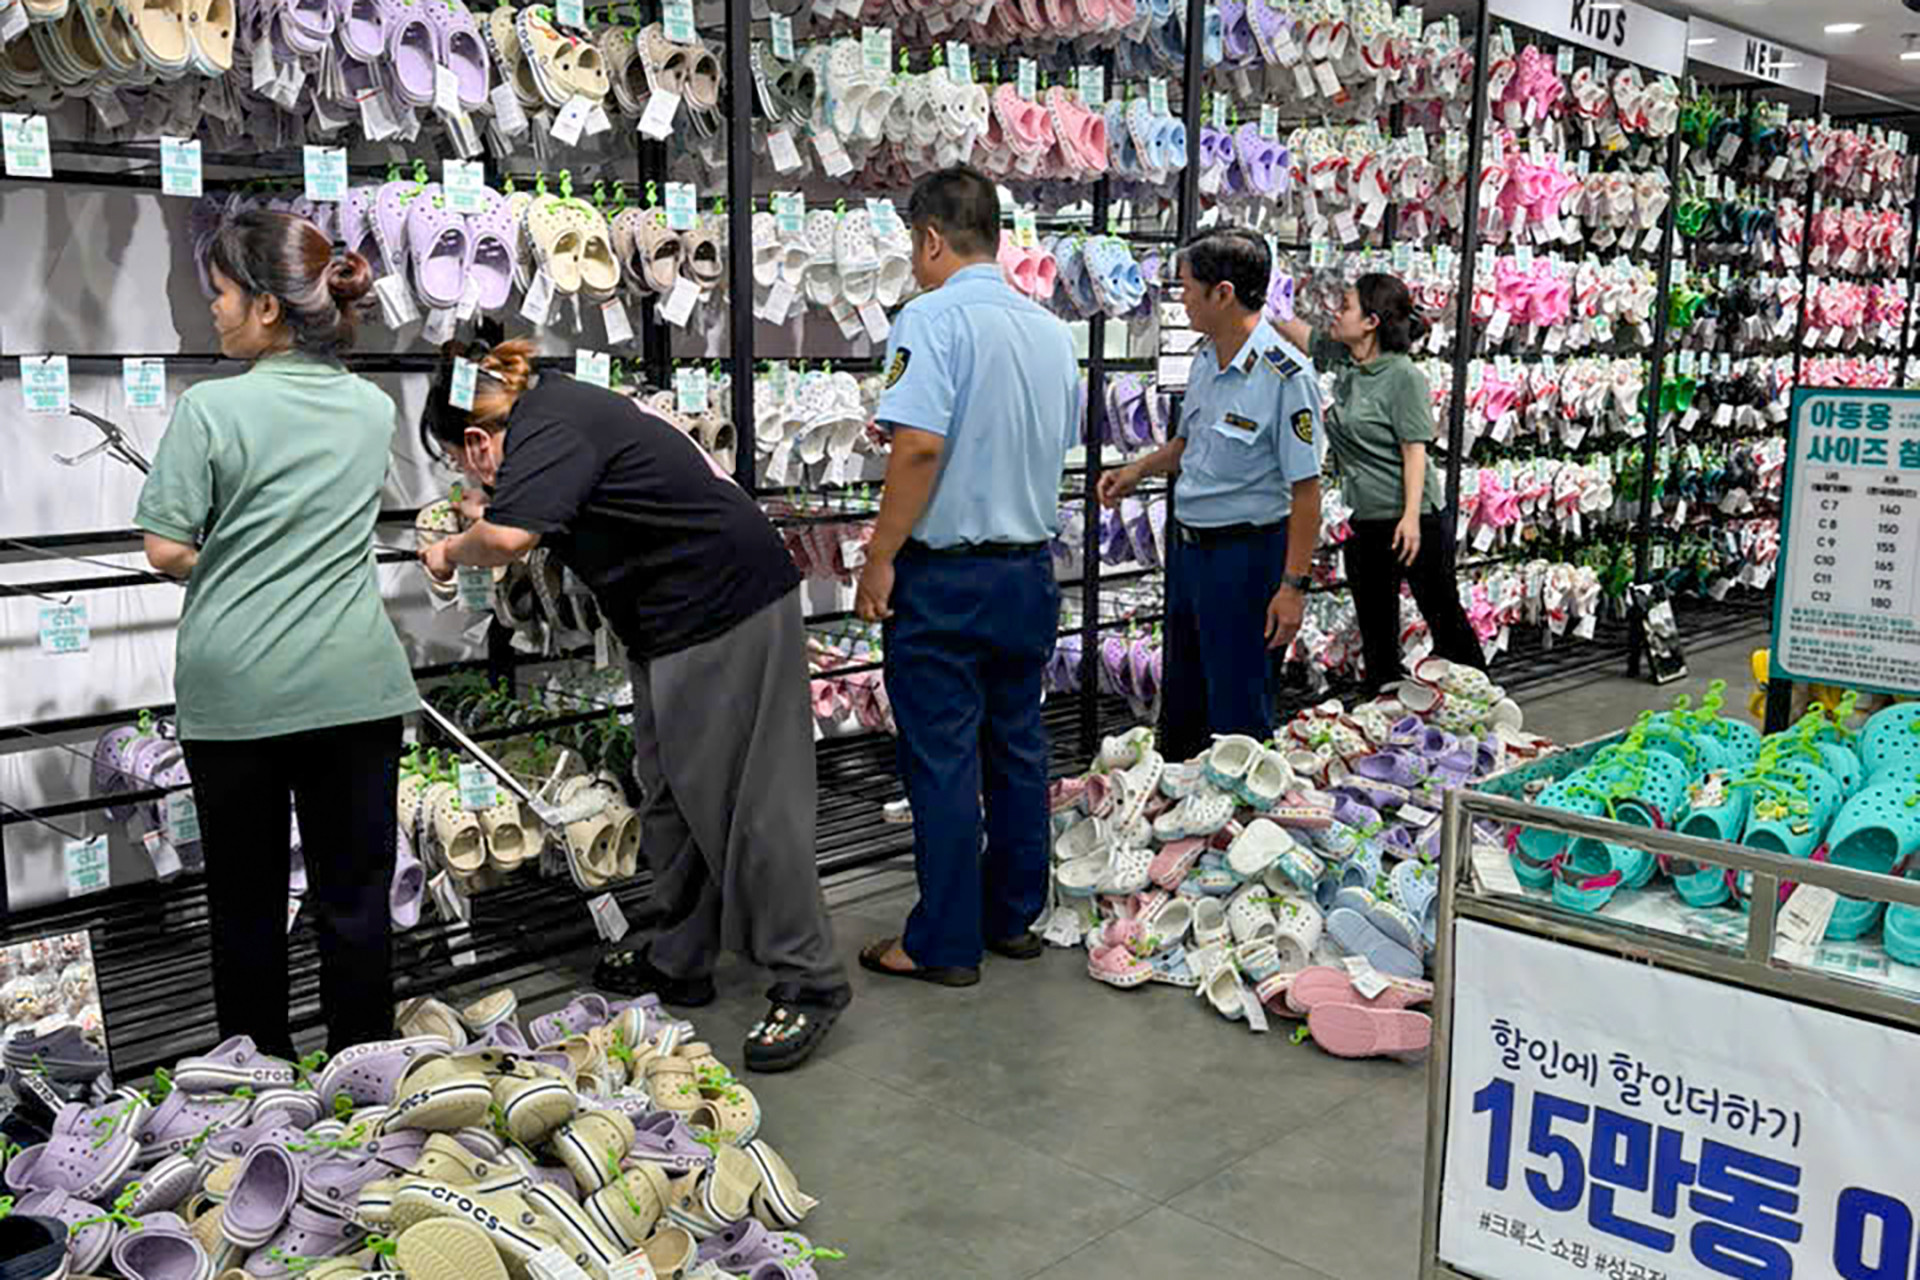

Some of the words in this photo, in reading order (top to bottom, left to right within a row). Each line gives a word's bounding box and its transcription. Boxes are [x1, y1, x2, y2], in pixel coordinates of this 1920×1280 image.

[1570, 0, 1626, 47] KIDS
[1811, 401, 1891, 431] 아동용
[1807, 435, 1888, 465] 사이즈
[1880, 504, 1901, 515] 140
[1878, 523, 1899, 534] 150
[1876, 542, 1896, 553] 155
[1814, 554, 1835, 566] C10
[1875, 560, 1894, 572] 165
[1813, 572, 1832, 584] C11
[1873, 579, 1892, 590] 175
[1811, 590, 1832, 602] C12
[1871, 597, 1892, 609] 180
[253, 1069, 294, 1081] croc
[1491, 1017, 1599, 1087] 할인에
[1608, 1052, 1801, 1148] 할인더하기
[1472, 1076, 1802, 1280] 15만동
[429, 1185, 502, 1232] crocs
[1478, 1211, 1546, 1251] #크록스
[1550, 1238, 1590, 1269] 쇼핑
